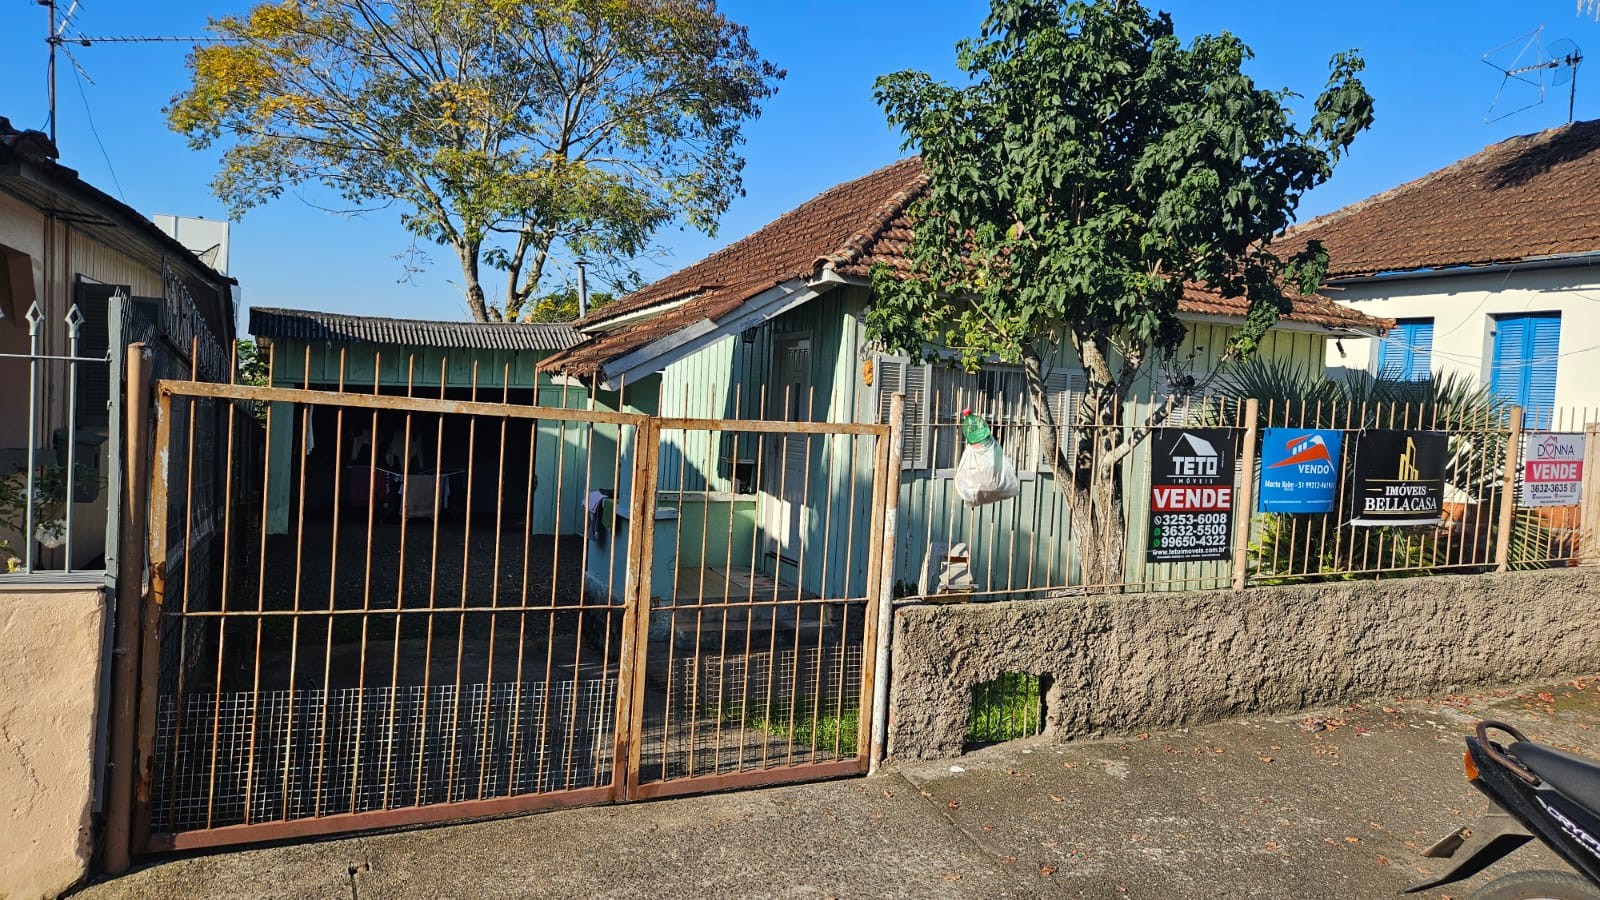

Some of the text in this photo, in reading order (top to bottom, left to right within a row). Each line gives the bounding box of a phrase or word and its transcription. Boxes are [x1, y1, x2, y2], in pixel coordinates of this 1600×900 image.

[1172, 456, 1217, 475] TETO
[1298, 464, 1330, 474] VENDO
[1532, 463, 1577, 480] VENDE
[1385, 482, 1427, 496] IMÓVEIS
[1530, 483, 1568, 493] 3632-3635
[1153, 489, 1231, 508] VENDE
[1162, 513, 1228, 525] 3253-6008
[1161, 524, 1227, 536] 3632-5500
[1161, 535, 1226, 547] 99650-4322
